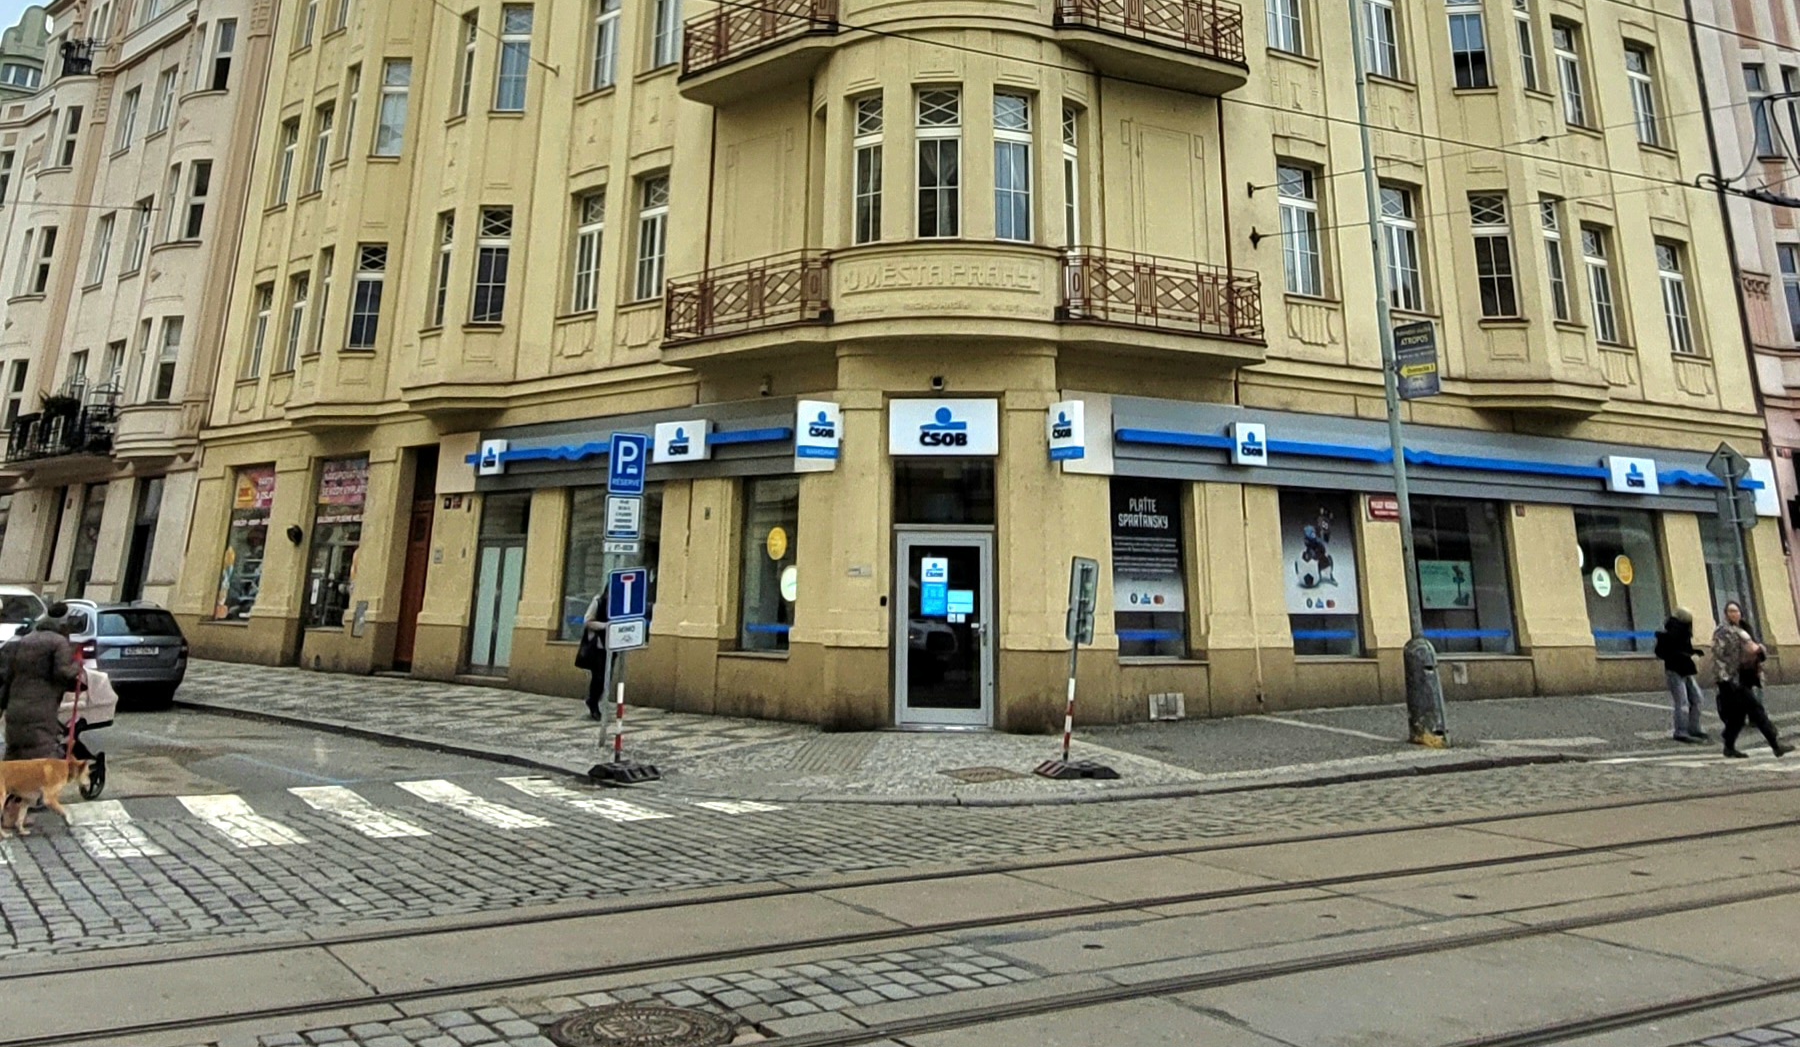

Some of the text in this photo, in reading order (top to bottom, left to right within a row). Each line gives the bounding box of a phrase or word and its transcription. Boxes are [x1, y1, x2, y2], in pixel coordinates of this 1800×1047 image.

[1400, 334, 1429, 346] ATROPOS
[809, 426, 835, 438] ČSOB
[919, 430, 968, 446] ČSOB
[1052, 427, 1072, 439] ČSOB
[616, 441, 639, 475] P
[1129, 496, 1157, 513] PLAŤTE
[1118, 512, 1169, 529] SPARŤANSKY
